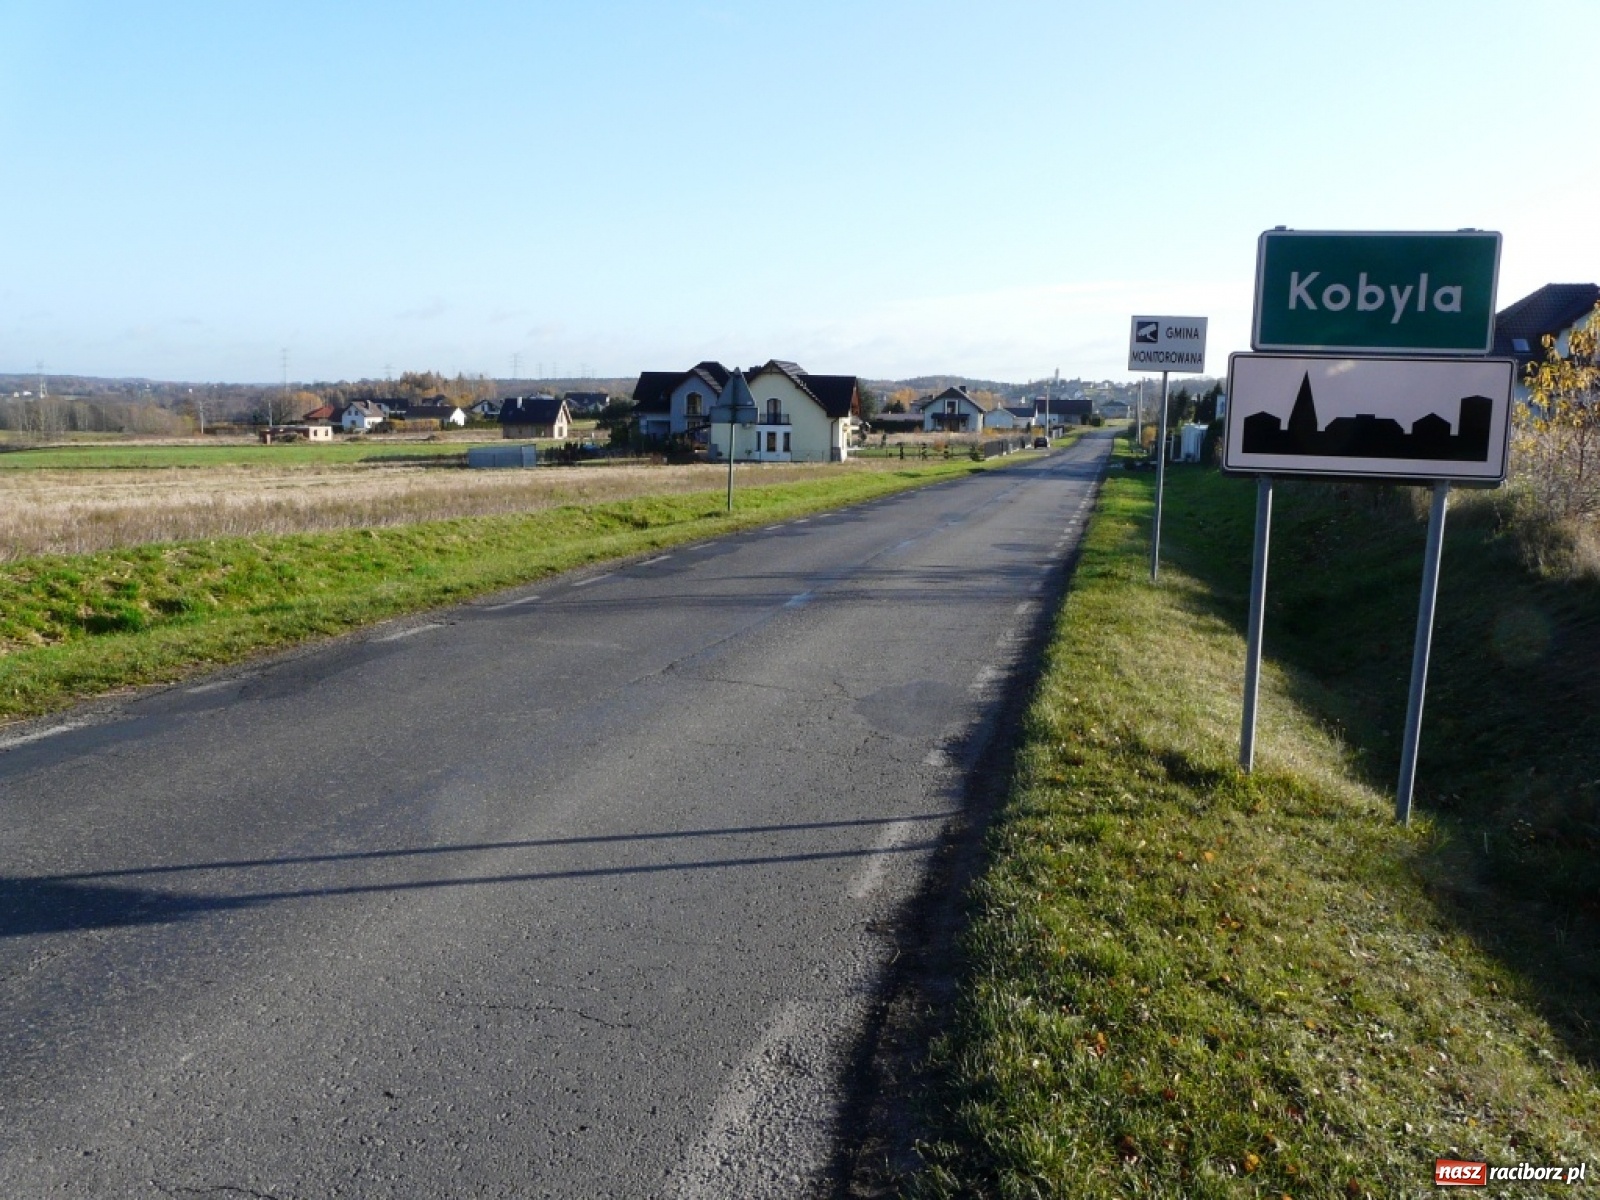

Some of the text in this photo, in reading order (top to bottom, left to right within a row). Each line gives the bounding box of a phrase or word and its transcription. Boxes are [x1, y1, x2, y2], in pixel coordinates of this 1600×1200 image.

[1288, 271, 1462, 324] Kobyla
[1165, 326, 1200, 340] GMINA
[1131, 350, 1203, 364] MONITOROWANA
